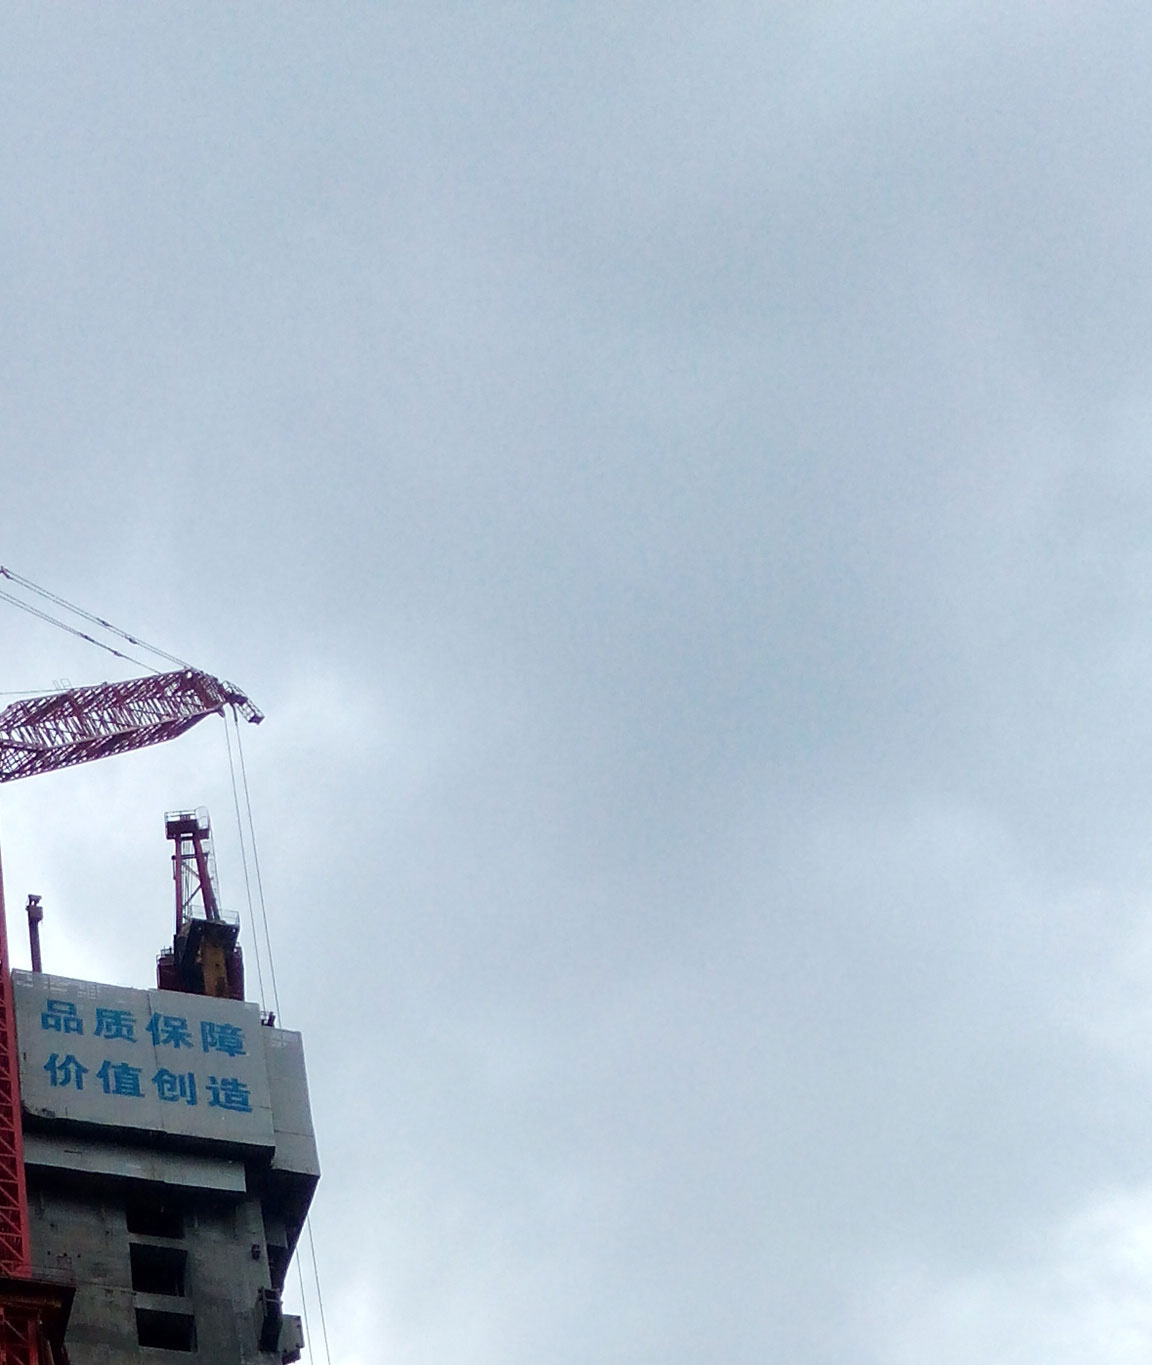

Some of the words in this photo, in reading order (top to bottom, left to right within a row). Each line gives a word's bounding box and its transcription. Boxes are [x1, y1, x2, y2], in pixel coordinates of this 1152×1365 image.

[40, 999, 247, 1057] 品质保障
[42, 1052, 254, 1113] 价值创造
